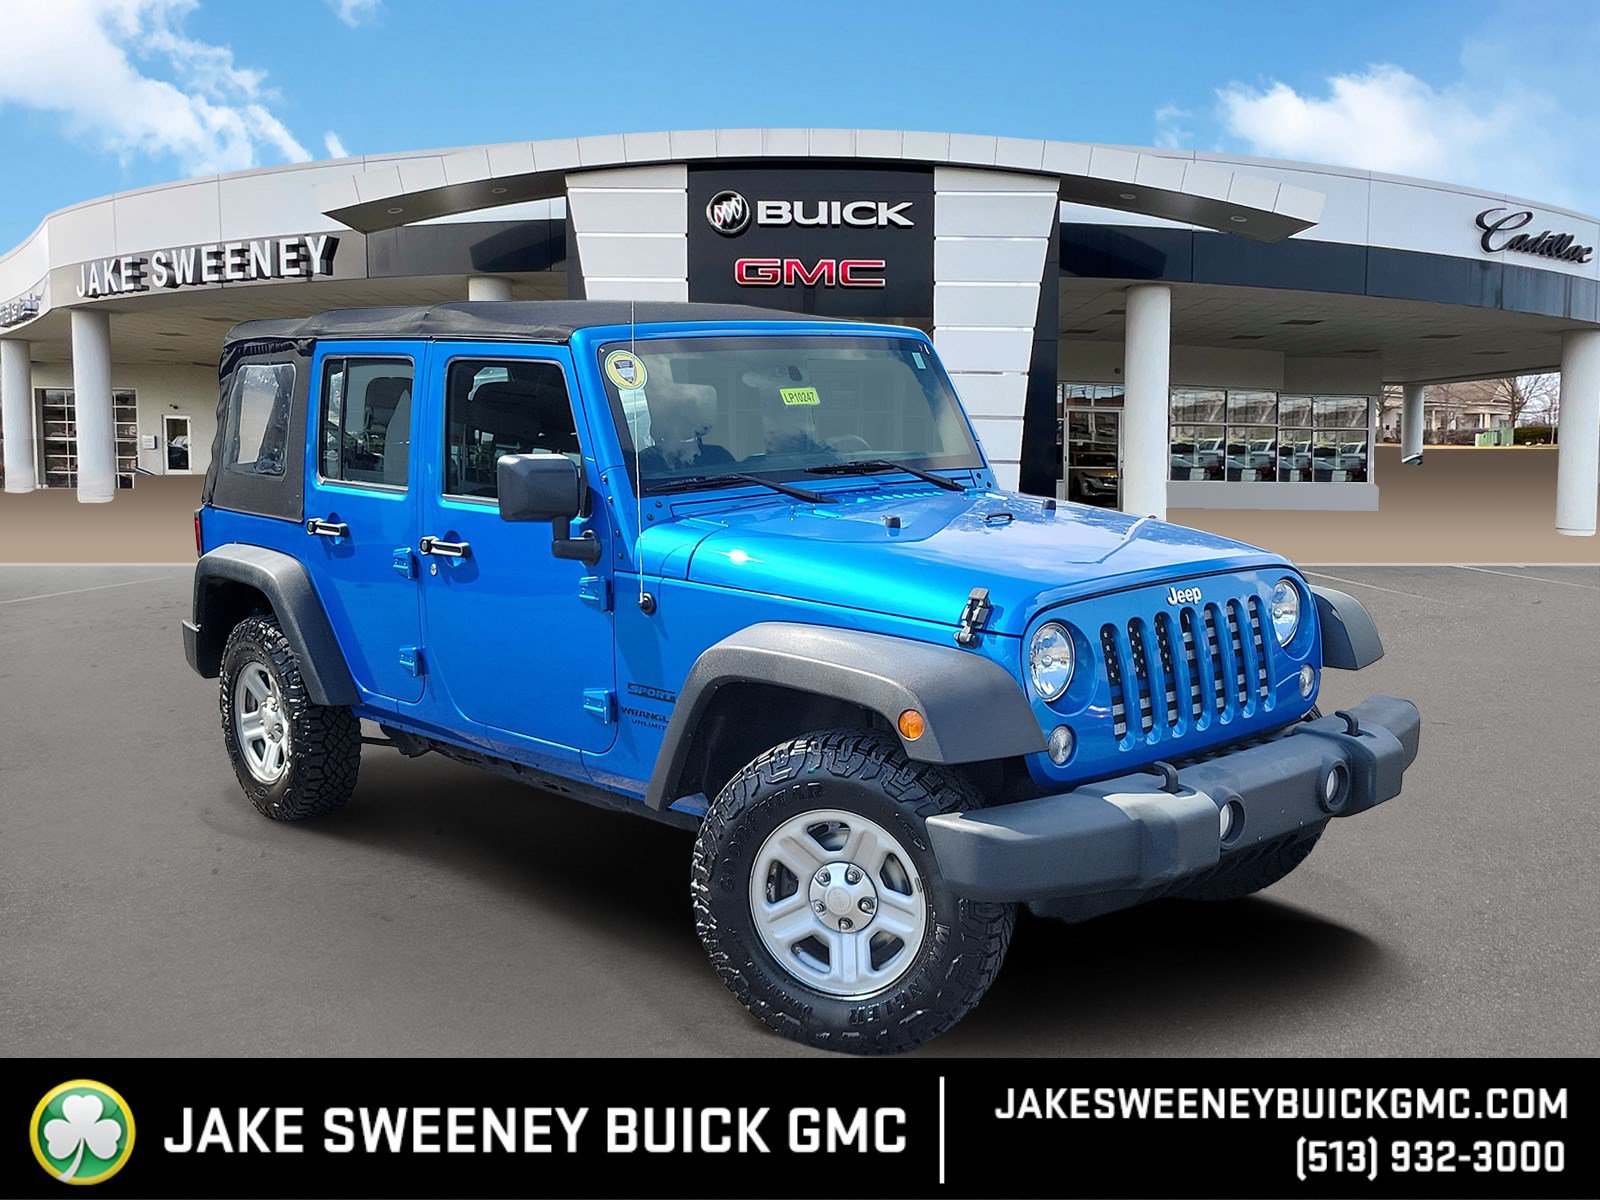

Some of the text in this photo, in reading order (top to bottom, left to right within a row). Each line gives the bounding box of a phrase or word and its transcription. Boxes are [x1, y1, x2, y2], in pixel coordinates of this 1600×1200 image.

[756, 200, 915, 227] BUICK
[1475, 207, 1593, 264] Cadillac
[76, 235, 335, 298] JAKE SWEENEY
[734, 258, 886, 287] GMC
[783, 391, 816, 403] LP10247
[1167, 586, 1202, 606] Jeep
[621, 707, 669, 723] WRANGL
[631, 719, 667, 730] UNLIMIT
